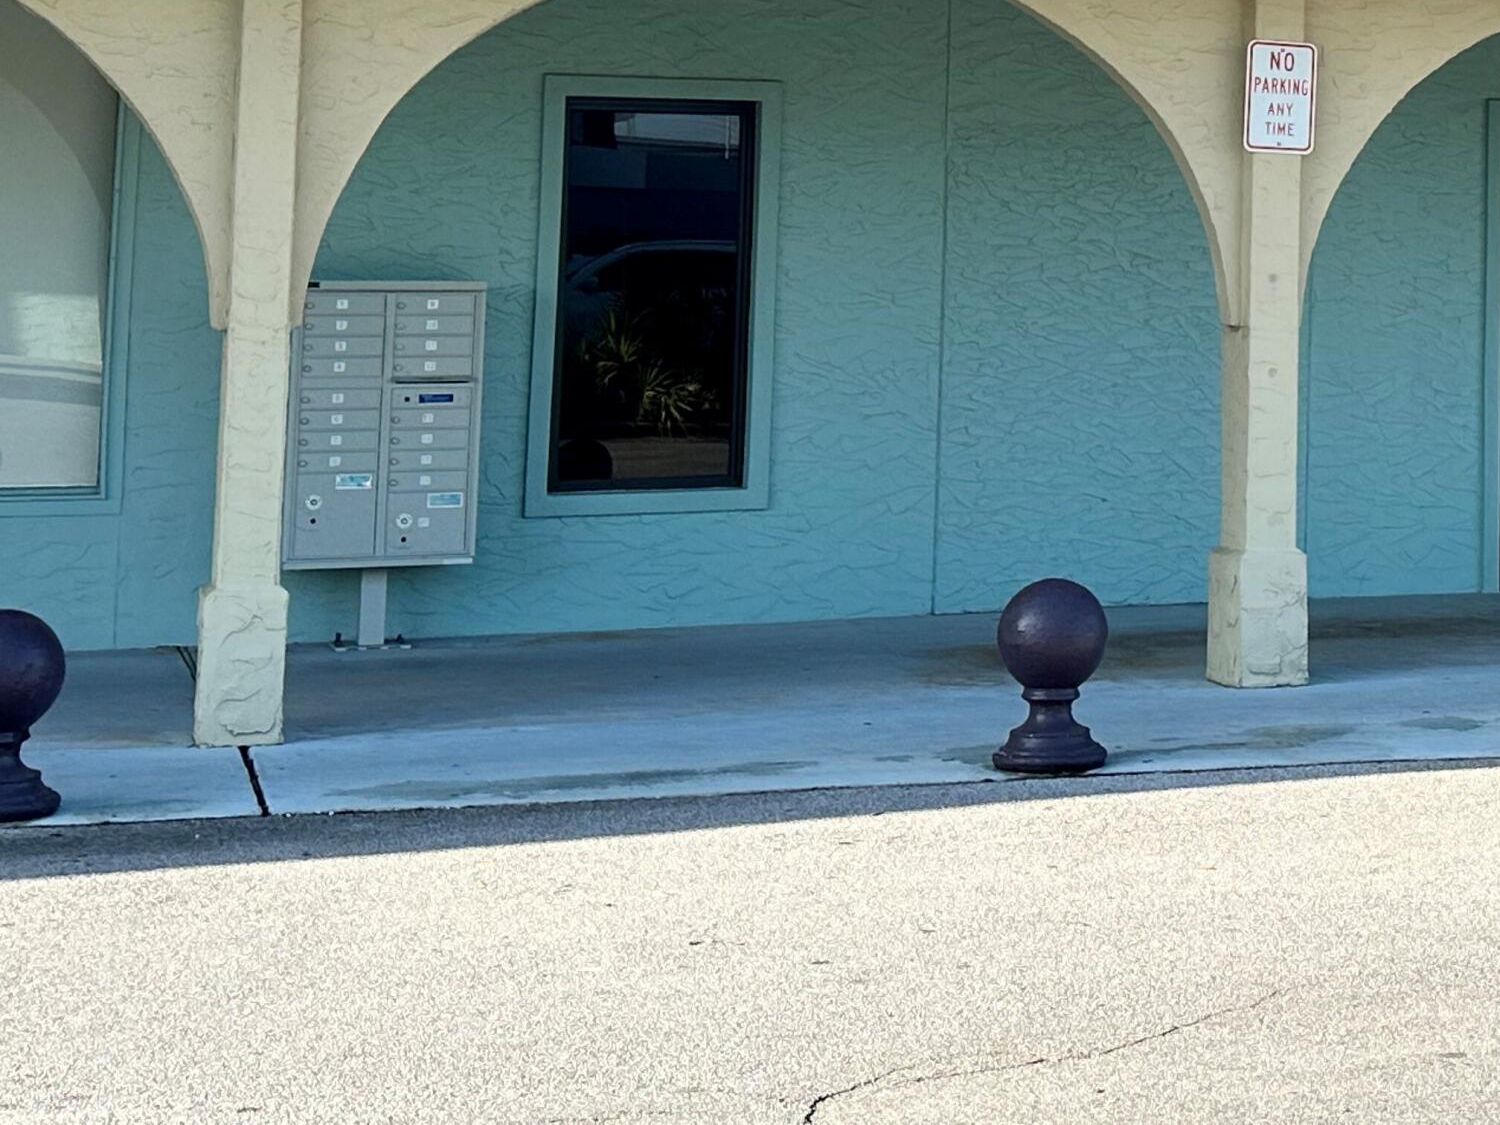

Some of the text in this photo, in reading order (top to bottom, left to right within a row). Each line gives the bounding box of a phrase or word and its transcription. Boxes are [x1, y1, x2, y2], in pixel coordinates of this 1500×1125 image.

[1270, 51, 1295, 72] NO
[1254, 76, 1309, 96] PARKING
[1267, 102, 1293, 116] ANY
[1265, 121, 1294, 136] TIME
